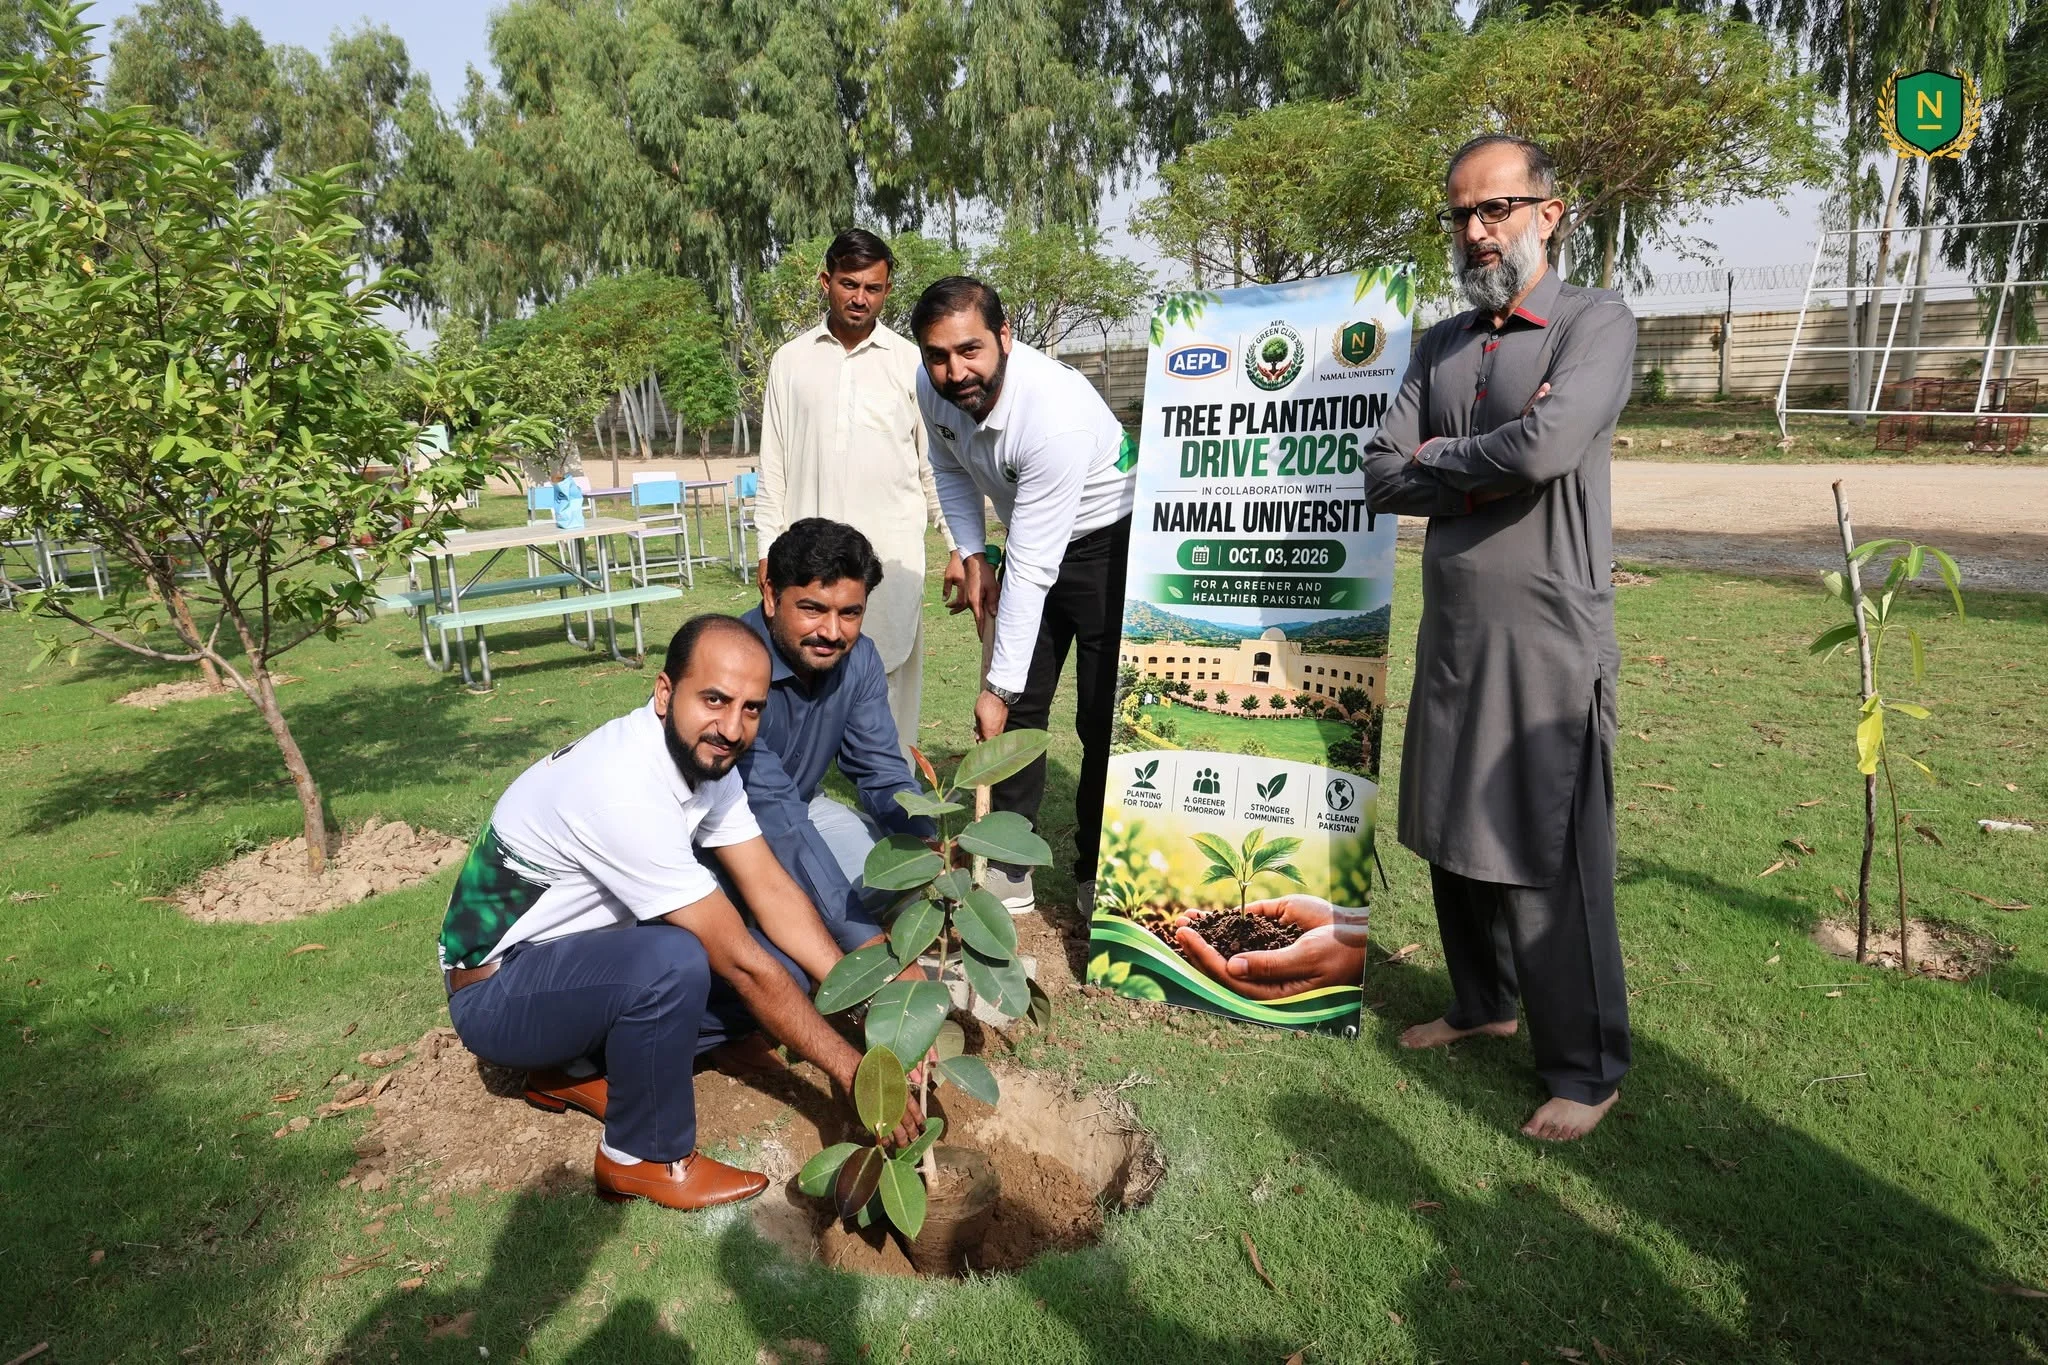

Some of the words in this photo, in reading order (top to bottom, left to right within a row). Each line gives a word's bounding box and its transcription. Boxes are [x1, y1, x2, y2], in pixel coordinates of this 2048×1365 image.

[1256, 328, 1279, 344] GREEN
[1280, 328, 1297, 342] CLUB
[1352, 332, 1366, 349] N
[1173, 353, 1222, 371] AEPL
[1320, 372, 1347, 382] NAMAL
[1348, 368, 1396, 379] UNIVERSITY
[1161, 404, 1222, 437] TREE
[1228, 393, 1387, 435] PLANTATION
[1179, 437, 1270, 478] DRIVE
[1202, 487, 1212, 496] IN
[1215, 485, 1301, 495] COLLABORATION
[1305, 484, 1332, 494] WITH
[1153, 502, 1235, 532] NAMAL
[1242, 500, 1377, 532] UNIVERSITY
[1229, 547, 1262, 564] OCT.
[1265, 549, 1288, 567] 03,
[1291, 549, 1329, 565] 2026
[1193, 579, 1217, 590] FOR
[1222, 581, 1229, 590] A
[1234, 580, 1291, 591] GREENER
[1296, 582, 1322, 592] AND
[1192, 592, 1257, 604] HEALTHIER
[1262, 594, 1320, 605] PAKISTAN
[1126, 789, 1162, 800] PLANTING
[1123, 798, 1138, 807] FOR
[1140, 800, 1162, 810] TODAY
[1184, 796, 1190, 804] A
[1192, 796, 1226, 808] GREENER
[1183, 804, 1226, 817] TOMORROW
[1250, 803, 1290, 815] STRONGER
[1244, 812, 1295, 825] COMMUNITIES
[1316, 812, 1323, 820] A
[1325, 813, 1360, 825] CLEANER
[1318, 822, 1357, 834] PAKISTAN
